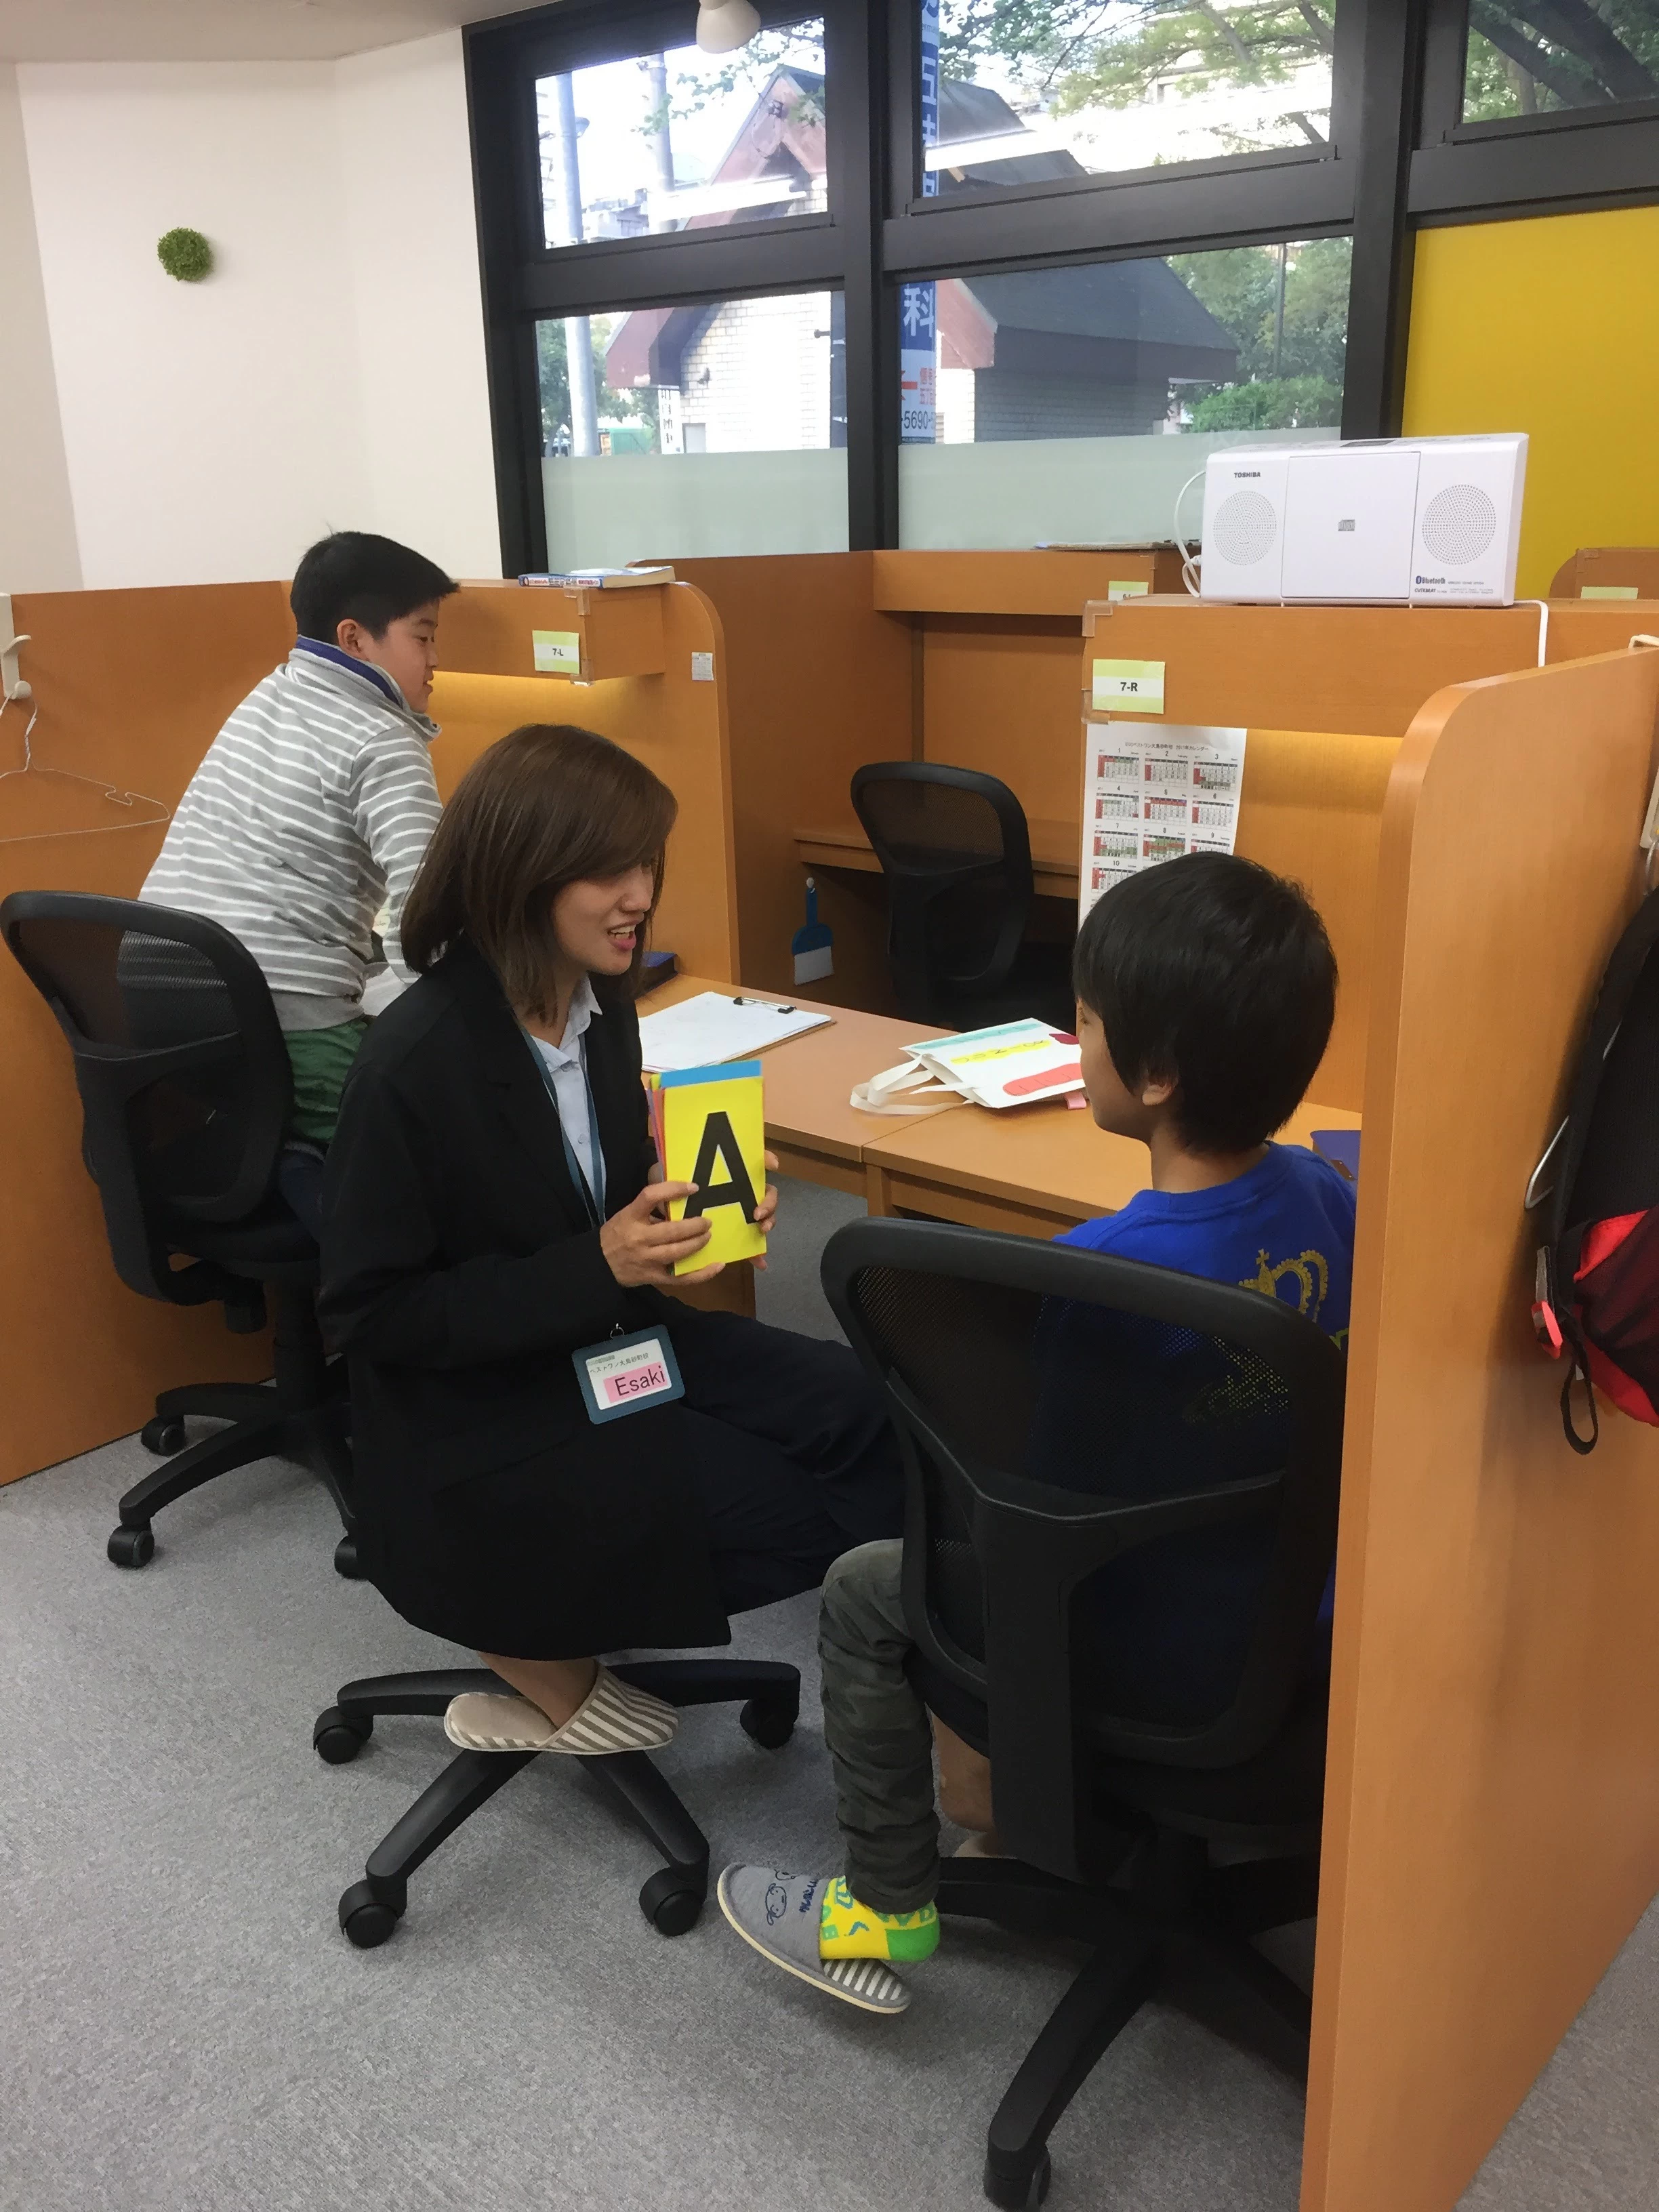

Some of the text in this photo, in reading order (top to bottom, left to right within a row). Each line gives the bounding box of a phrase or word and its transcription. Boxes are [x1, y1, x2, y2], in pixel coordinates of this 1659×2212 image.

[903, 285, 934, 337] 科
[1422, 576, 1446, 584] Bluetooth
[552, 648, 564, 657] 7-L
[1120, 681, 1139, 692] 7-R
[682, 1110, 758, 1225] A
[615, 1365, 665, 1396] Esaki
